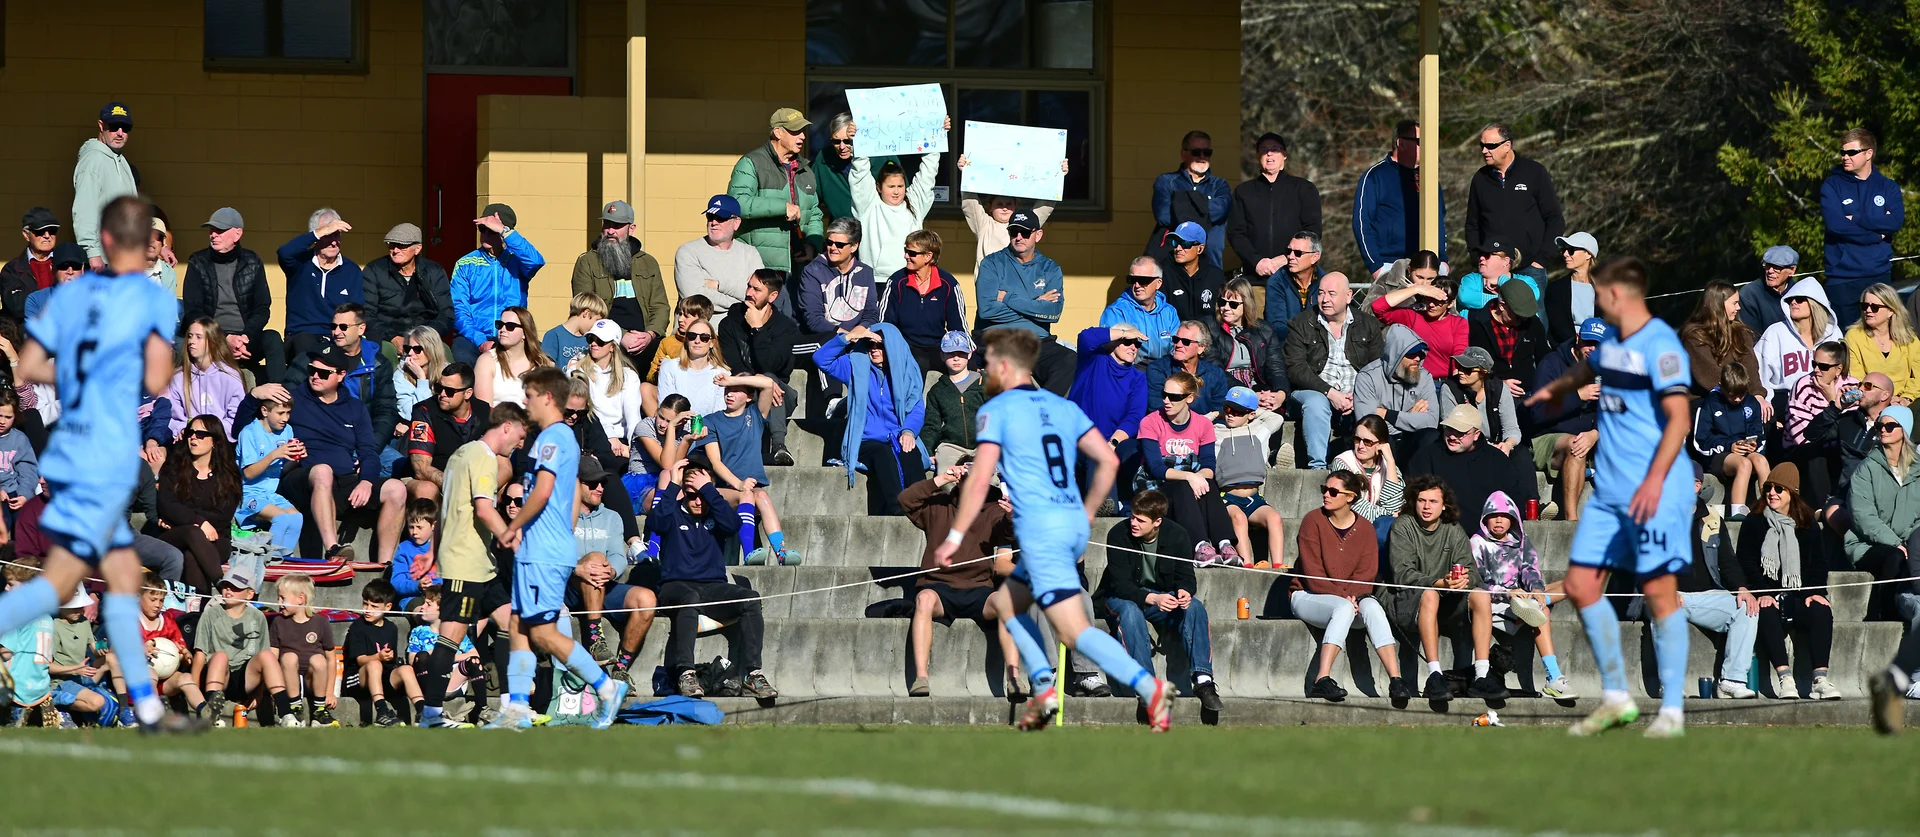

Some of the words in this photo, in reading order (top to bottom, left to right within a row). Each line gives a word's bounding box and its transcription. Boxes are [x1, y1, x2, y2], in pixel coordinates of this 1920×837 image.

[1041, 434, 1068, 489] 8
[1638, 529, 1666, 554] 24
[529, 585, 539, 605] 7
[459, 596, 475, 618] 11
